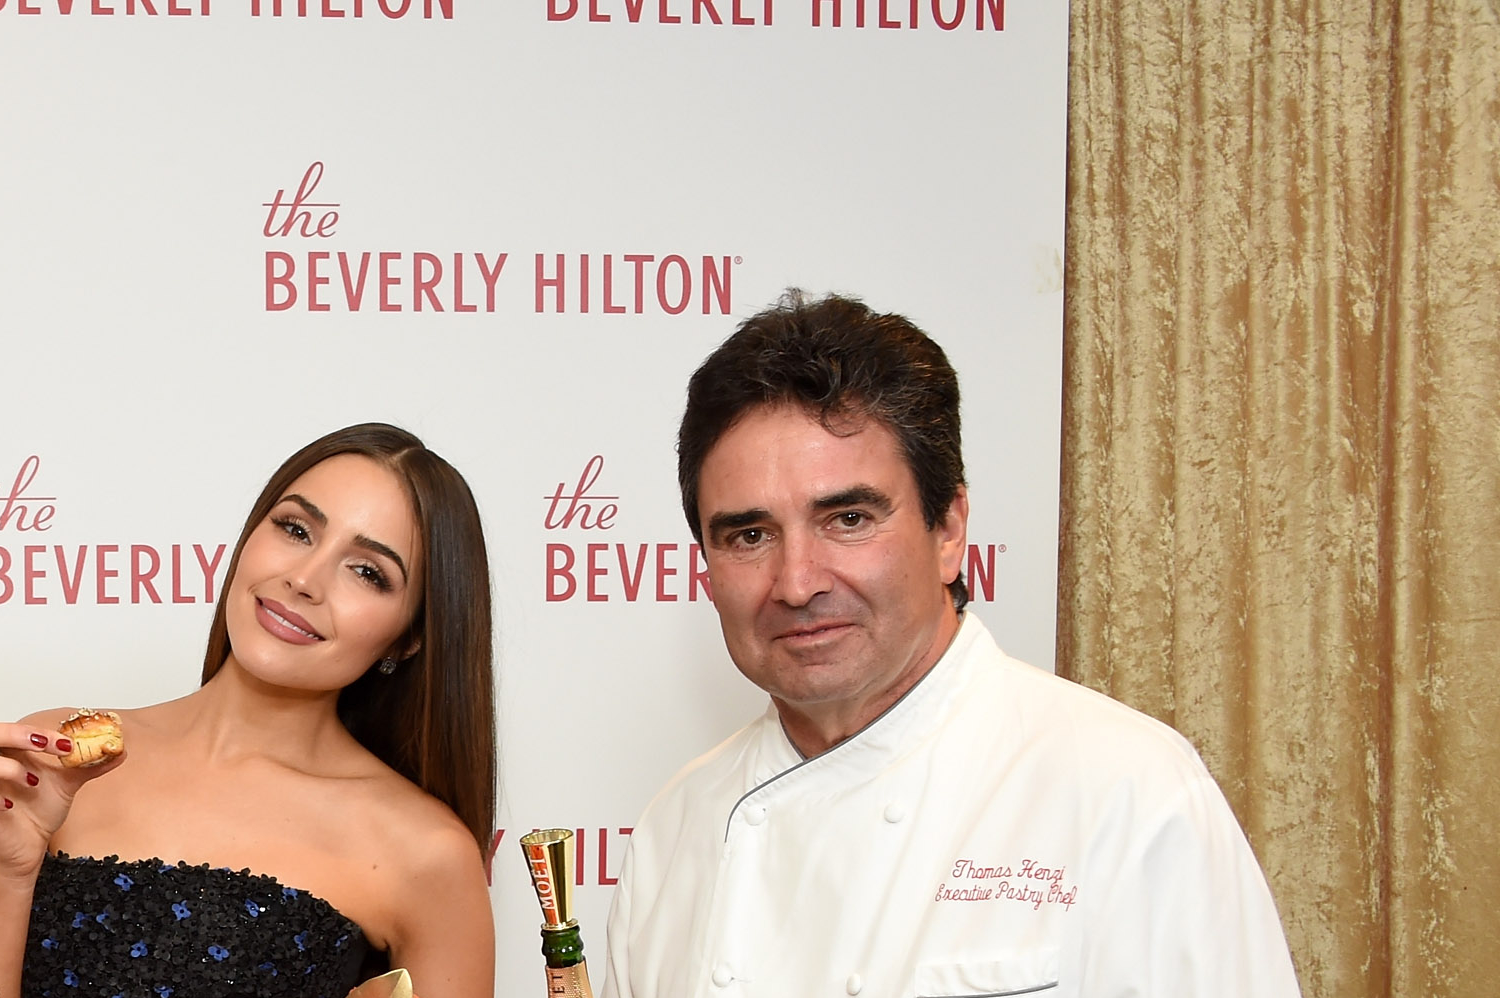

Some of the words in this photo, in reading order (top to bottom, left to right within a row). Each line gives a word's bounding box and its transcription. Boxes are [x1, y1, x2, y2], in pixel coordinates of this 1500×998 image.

[263, 161, 340, 238] the
[265, 251, 508, 313] BEVERLY
[544, 455, 619, 531] the
[545, 543, 712, 603] BEVER
[934, 883, 993, 902] Executive
[994, 881, 1044, 911] Pastry
[1046, 883, 1078, 912] Chef
[951, 859, 1013, 880] Thomas
[1016, 859, 1067, 884] Henzi
